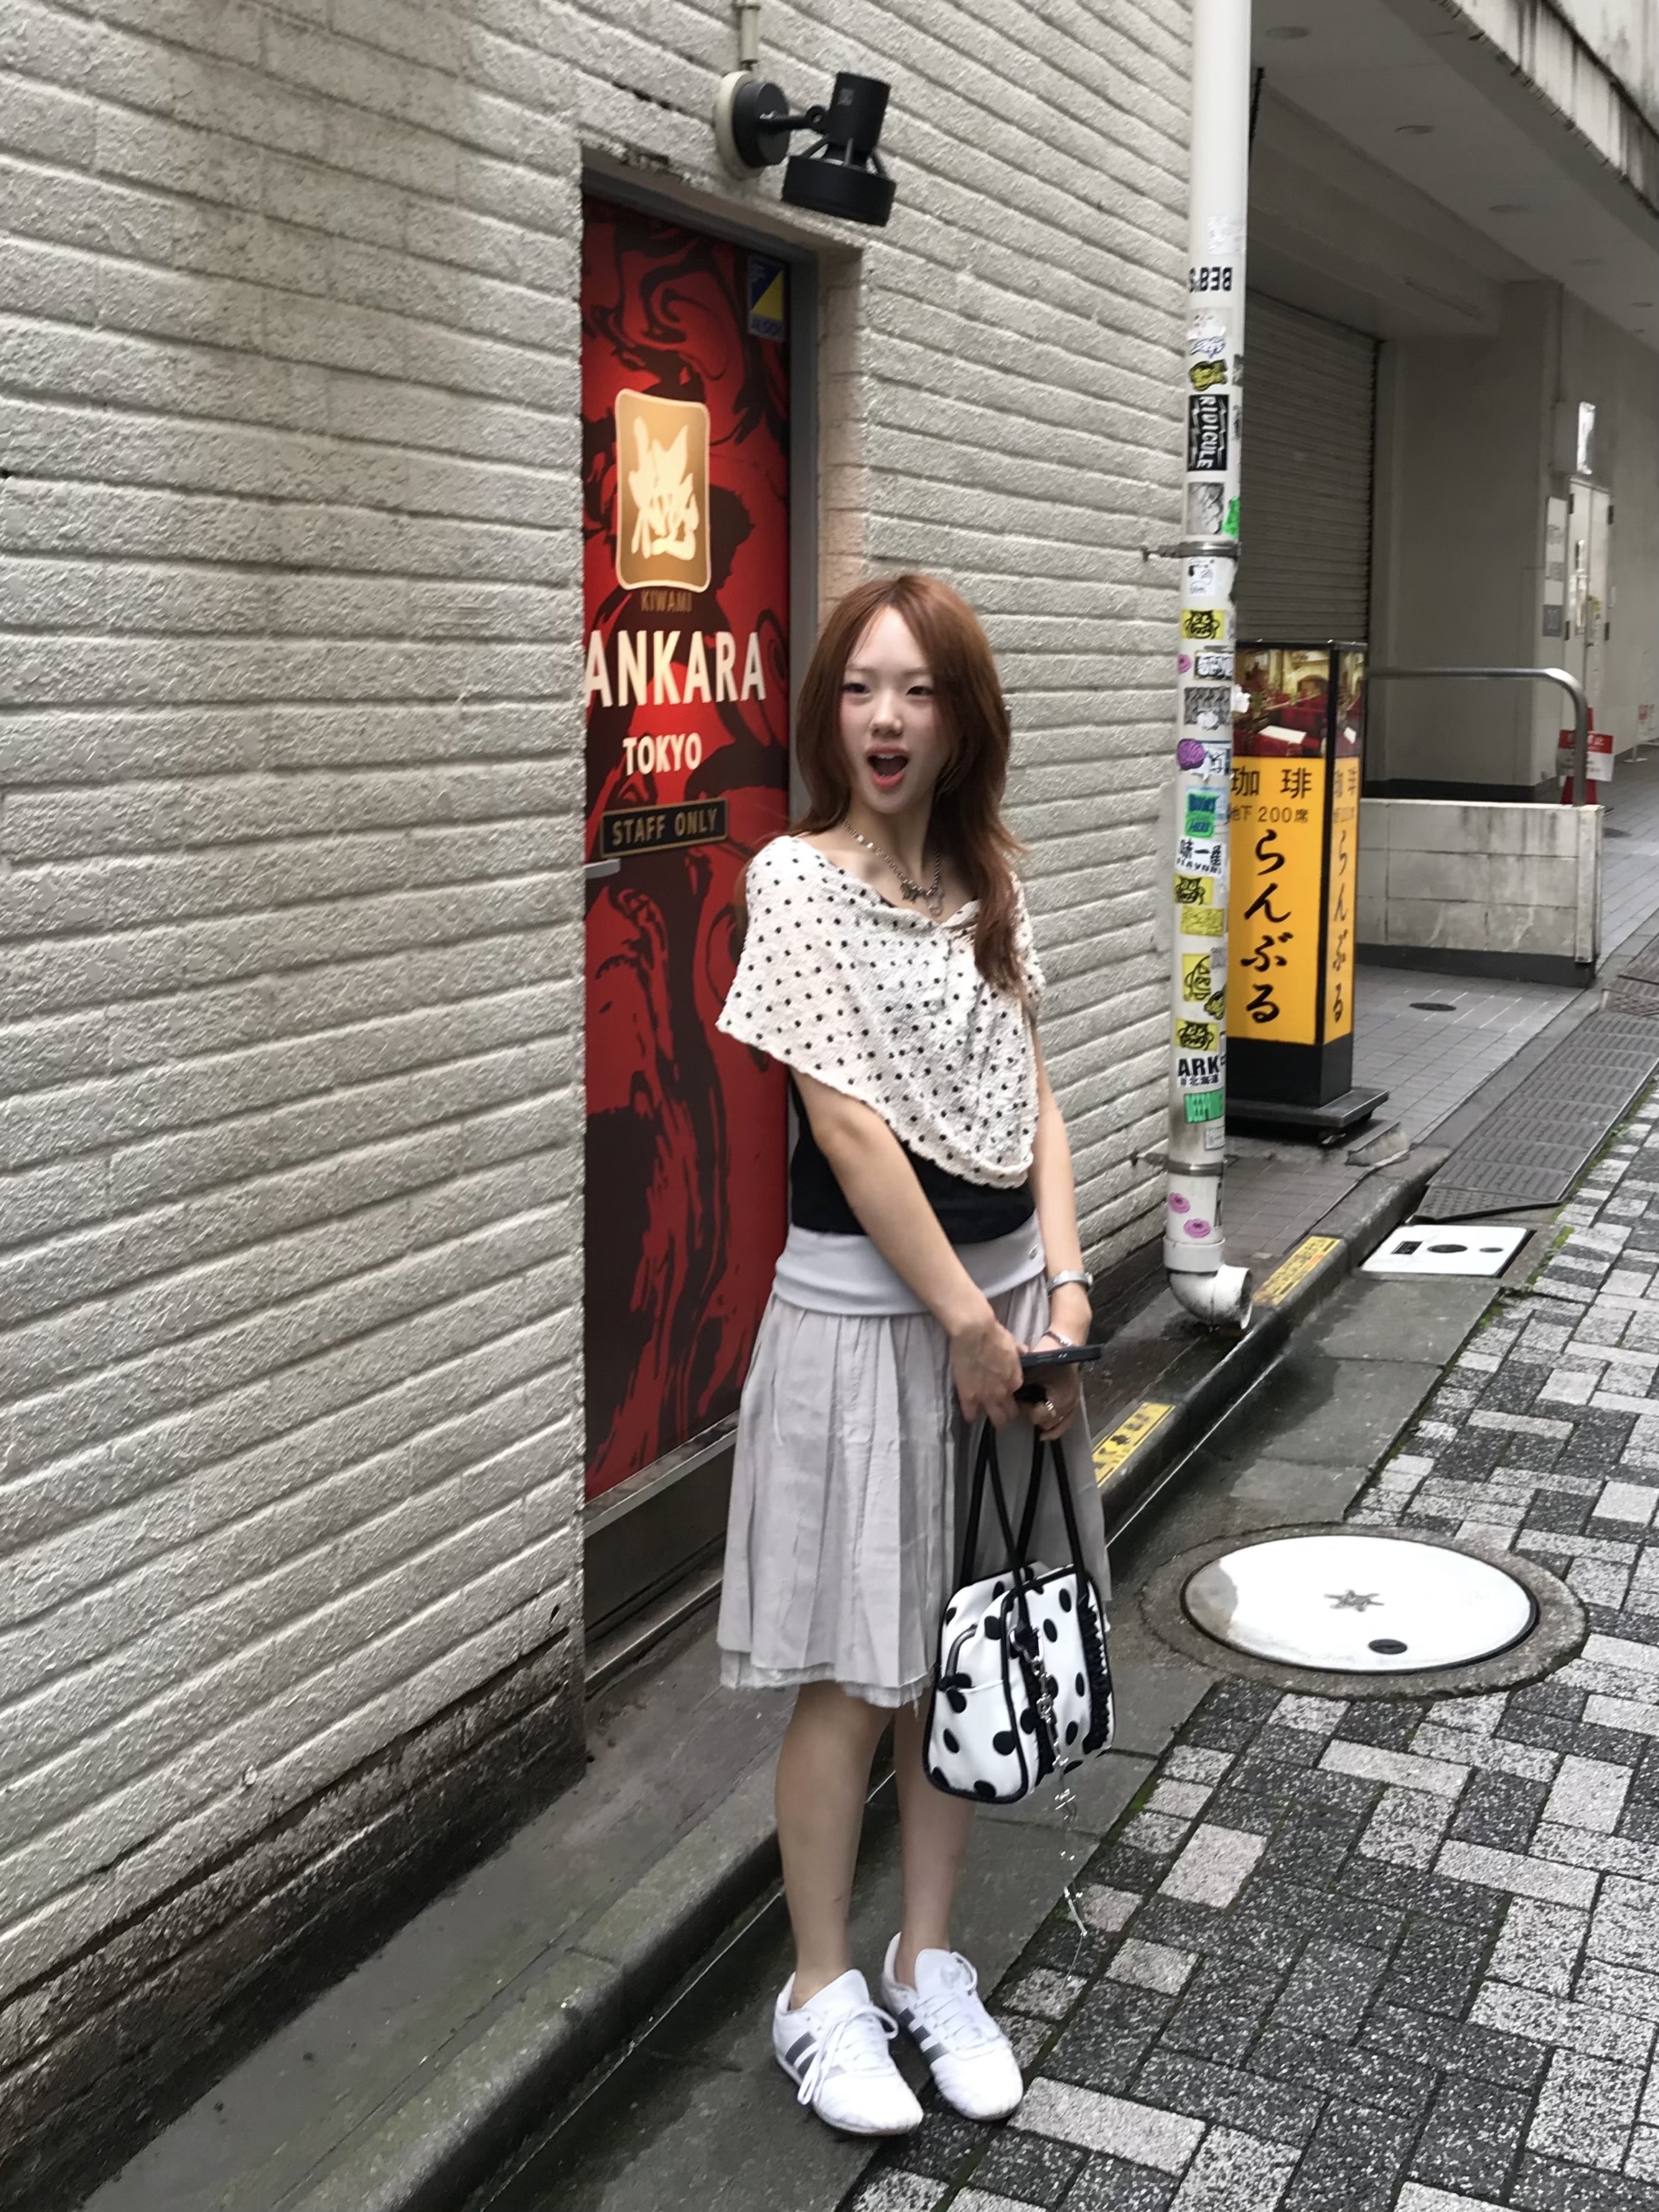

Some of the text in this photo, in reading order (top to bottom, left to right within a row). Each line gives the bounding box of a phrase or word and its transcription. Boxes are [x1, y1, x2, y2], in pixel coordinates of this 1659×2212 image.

[1197, 396, 1218, 468] RIDICULE
[623, 732, 702, 776] TOKYO
[612, 808, 717, 846] STAFF ONLY
[1240, 829, 1293, 1024] らんぶる
